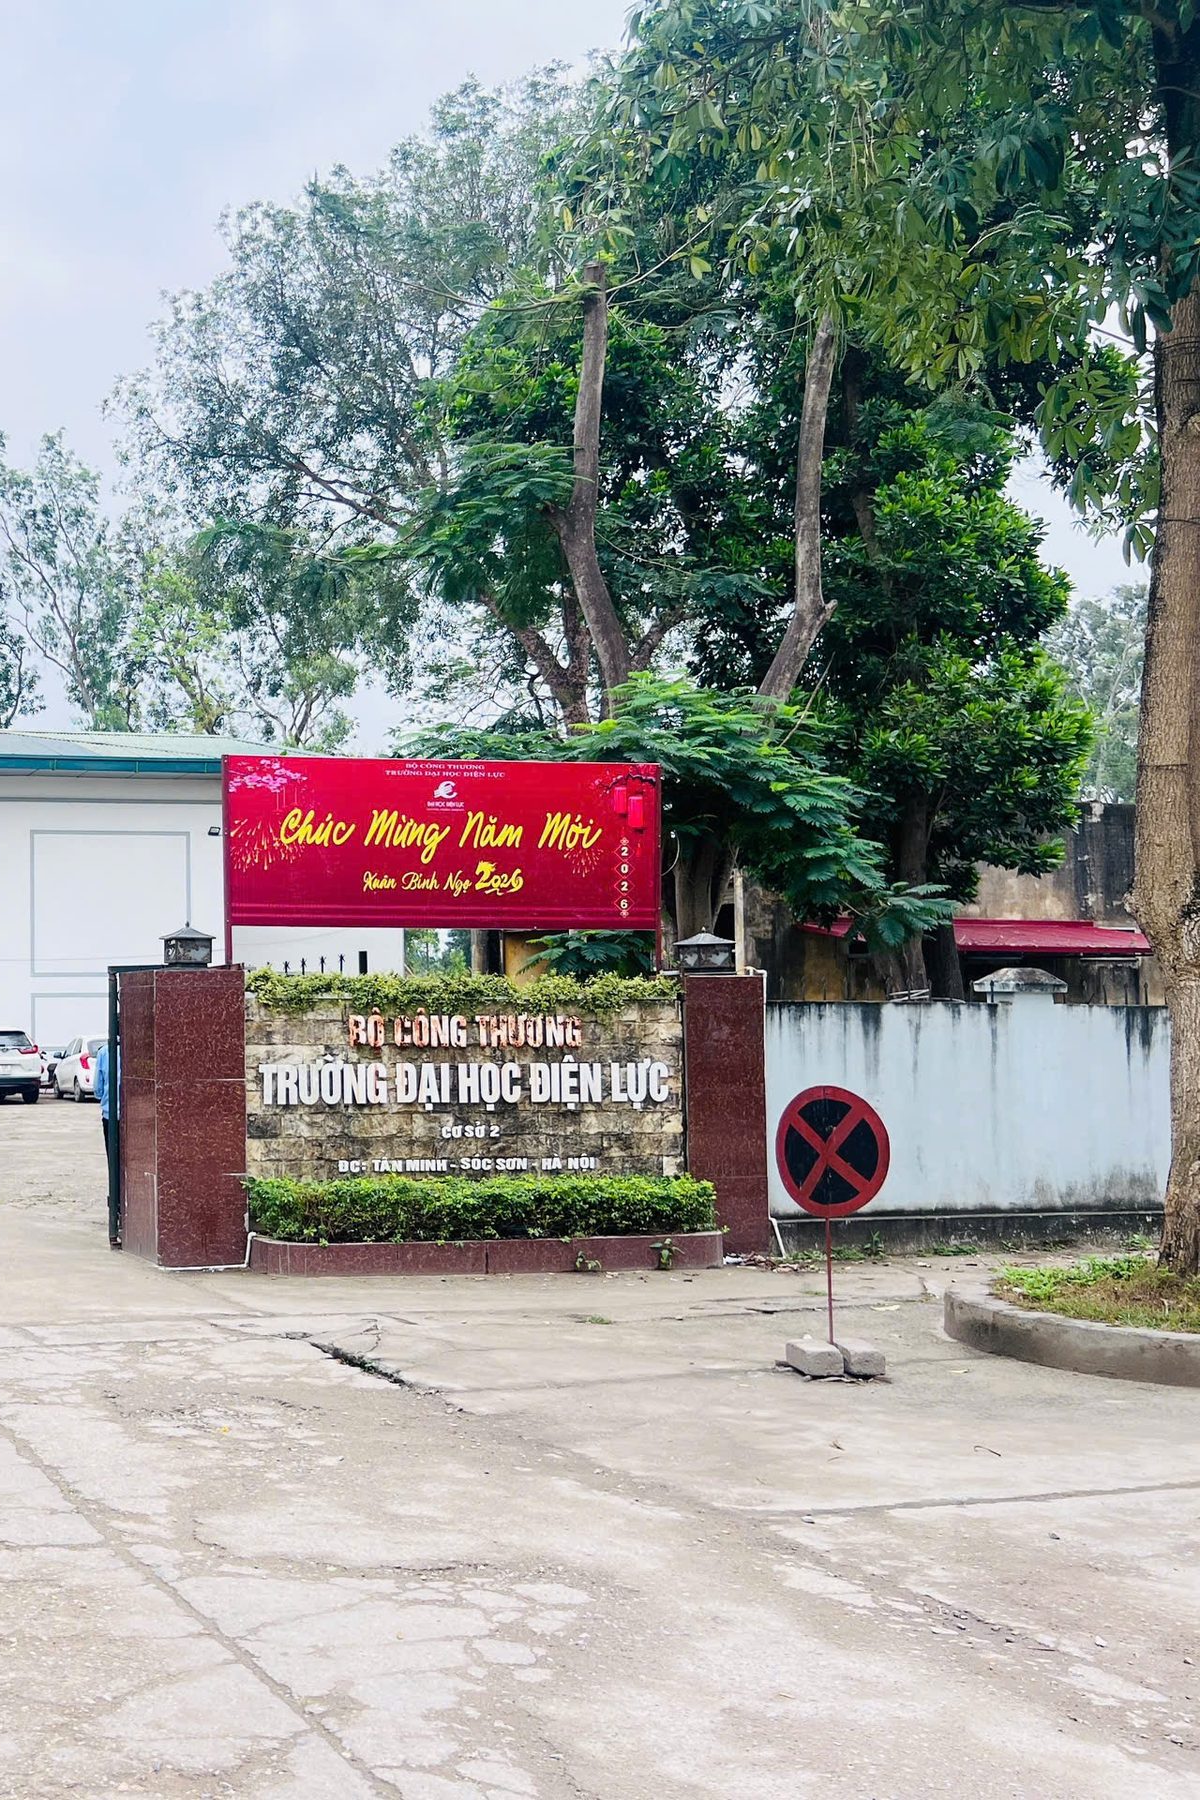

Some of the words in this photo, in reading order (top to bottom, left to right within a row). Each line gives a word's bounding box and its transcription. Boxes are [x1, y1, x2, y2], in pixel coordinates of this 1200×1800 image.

[279, 808, 356, 848] Chúc
[363, 809, 452, 864] Mừng
[458, 810, 524, 849] Năm
[537, 811, 603, 850] Mới
[363, 871, 397, 892] Xuân
[401, 871, 440, 890] Bính
[443, 870, 473, 897] Ngọ
[475, 860, 524, 896] 2026
[349, 1007, 385, 1055] BỘ
[394, 1007, 467, 1048] CÔNG
[475, 1012, 583, 1048] THƯƠNG
[259, 1053, 388, 1105] TRƯỜNG
[395, 1062, 450, 1111] ĐẠI
[458, 1062, 522, 1111] HỌC
[529, 1054, 601, 1110] ĐIỆN
[611, 1058, 669, 1110] LỰC
[441, 1125, 462, 1139] CƠ
[464, 1121, 486, 1138] SỞ
[489, 1125, 500, 1137] 2
[338, 1160, 367, 1173] ĐC:
[372, 1157, 403, 1173] TÂN
[405, 1160, 448, 1172] MINH
[460, 1153, 493, 1171] SÓC
[495, 1157, 528, 1170] SƠN
[541, 1153, 562, 1170] HÀ
[567, 1153, 596, 1172] NỘI
